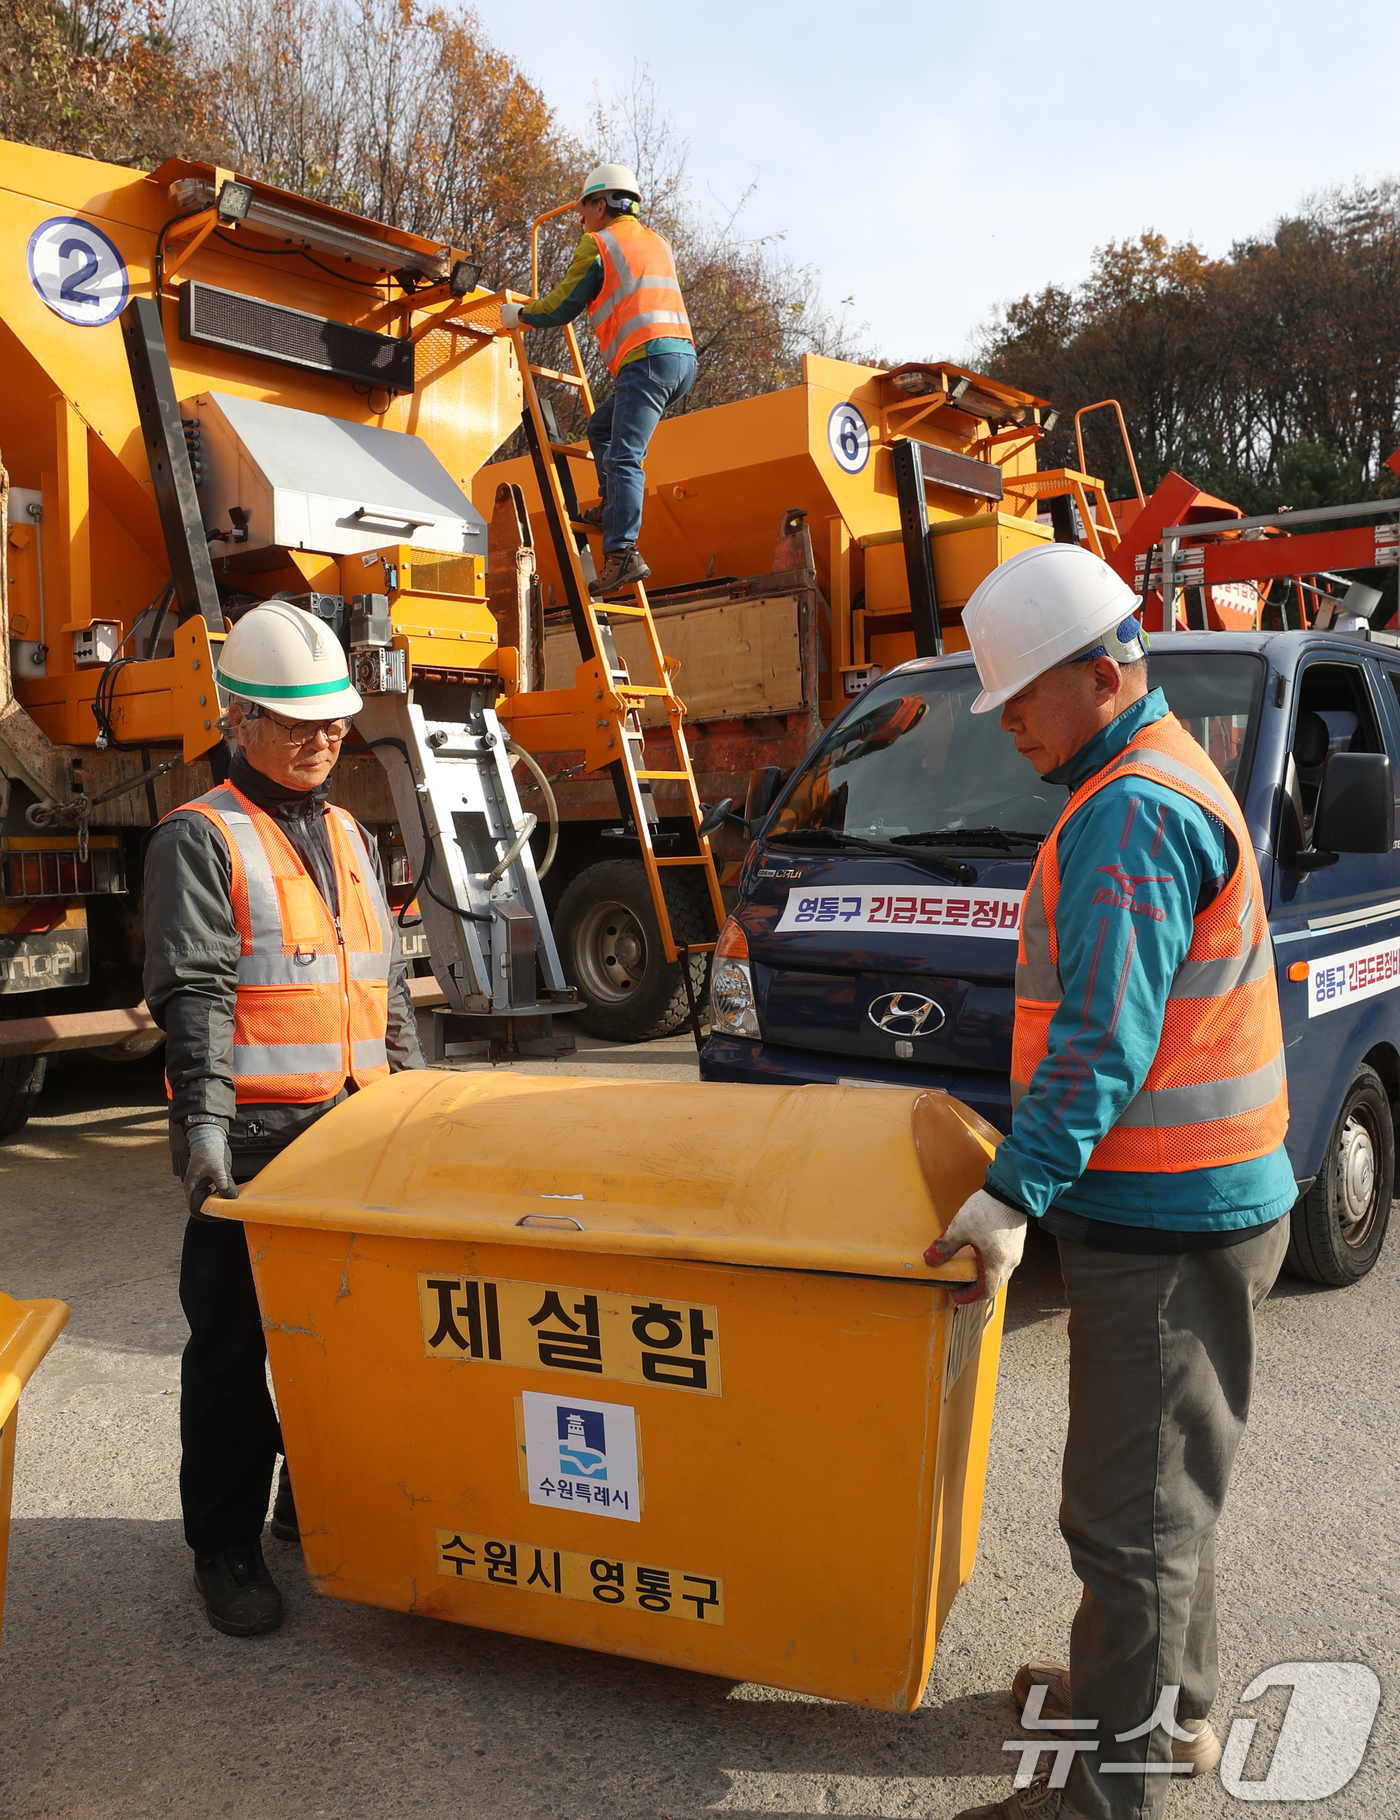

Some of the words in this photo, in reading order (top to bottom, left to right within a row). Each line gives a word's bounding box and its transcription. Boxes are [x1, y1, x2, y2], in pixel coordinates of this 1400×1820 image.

[58, 238, 99, 307] 2
[840, 415, 860, 461] 6
[795, 896, 862, 922] 영통구
[1315, 964, 1346, 1002] 영통구
[426, 1279, 714, 1390] 제설함
[539, 1477, 629, 1510] 수원특례시
[441, 1535, 562, 1594] 수원시
[589, 1559, 720, 1619] 영통구
